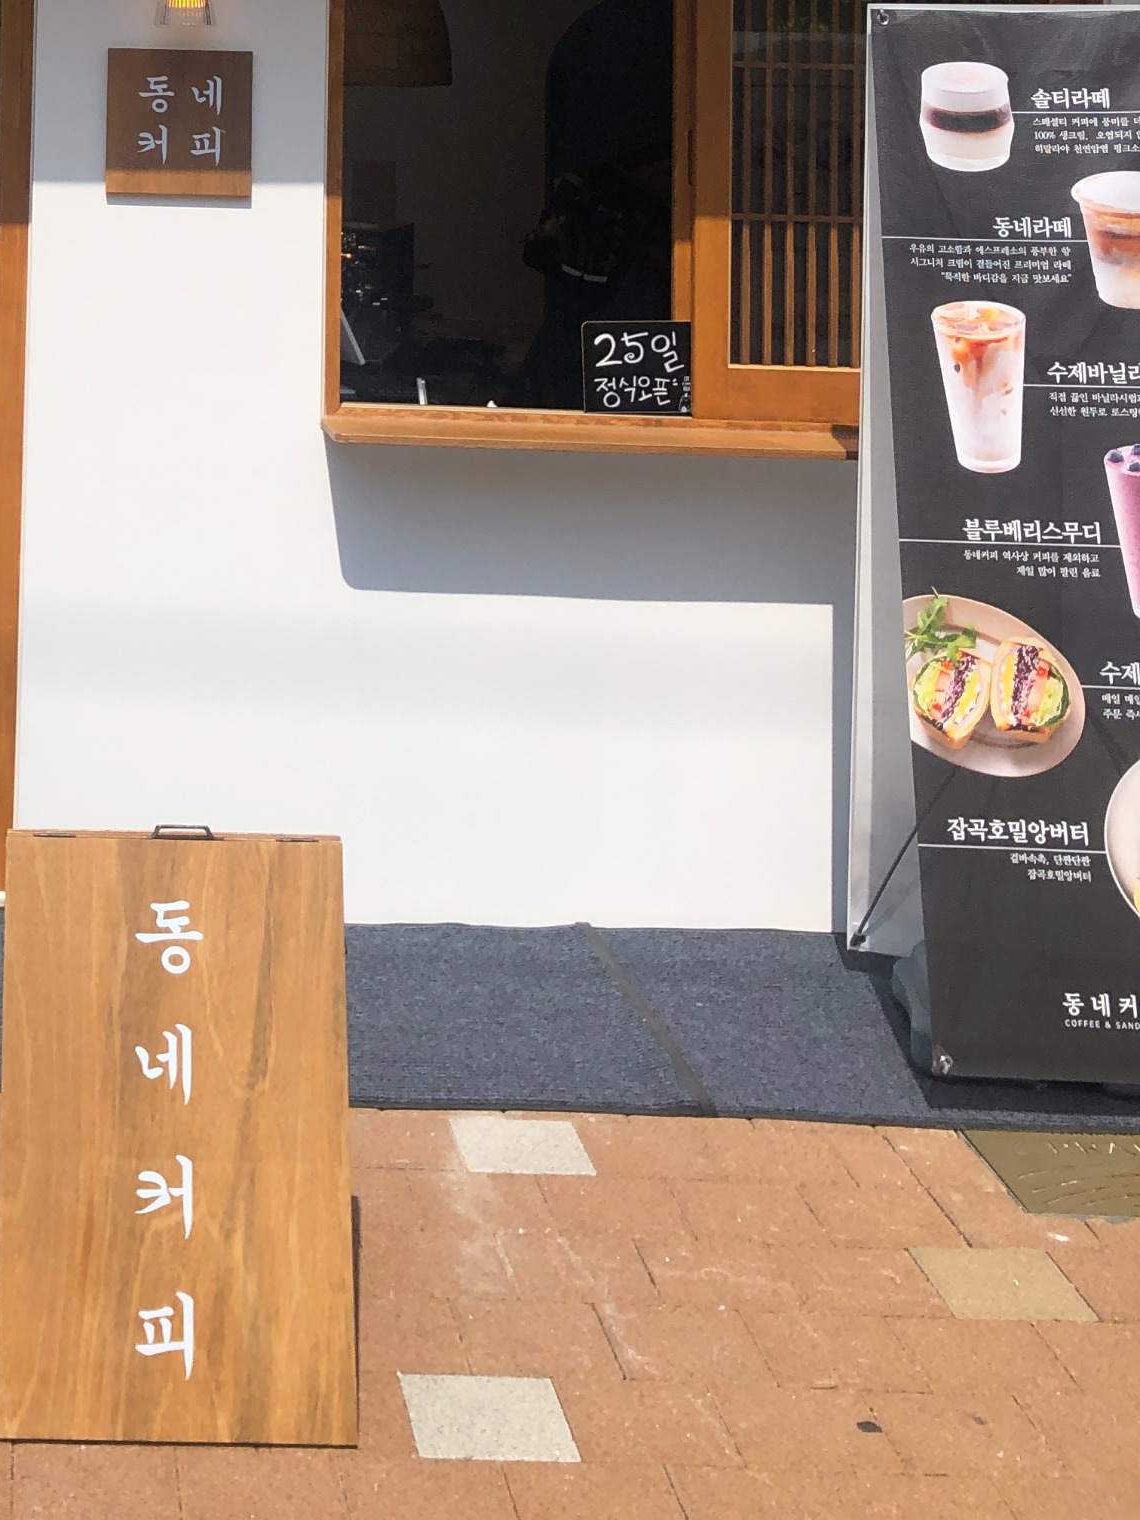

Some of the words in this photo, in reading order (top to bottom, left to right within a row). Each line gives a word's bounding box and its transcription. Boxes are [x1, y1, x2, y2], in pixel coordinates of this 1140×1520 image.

[138, 75, 222, 116] 동네
[1030, 87, 1111, 109] 솔티라떼
[1071, 116, 1099, 128] 커피에
[1101, 116, 1130, 128] 풍미를
[1034, 130, 1057, 140] 100%
[136, 124, 223, 167] 커피
[1034, 143, 1071, 154] 히말라야
[992, 216, 1072, 238] 동네라떼
[909, 243, 935, 254] 우유의
[938, 244, 972, 255] 고소함과
[975, 245, 1027, 256] 에스프레소의
[1030, 246, 1058, 257] 풍부한
[1060, 246, 1072, 257] 향
[910, 256, 944, 268] 시그니처
[947, 258, 973, 269] 크림이
[1014, 260, 1049, 271] 프리미엄
[1052, 260, 1072, 271] 라떼
[973, 272, 1008, 284] 바디감을
[1011, 273, 1030, 284] 지금
[593, 330, 685, 373] 25일
[1048, 392, 1067, 403] 직접
[1070, 392, 1089, 403] 끓인
[1049, 406, 1077, 417] 신선한
[1080, 406, 1108, 417] 원두로
[1111, 407, 1140, 418] 로스팅
[962, 518, 1102, 545] 블루베리스무디
[963, 549, 999, 561] 동네커피
[1002, 550, 1029, 562] 역사상
[1032, 551, 1060, 562] 커피를
[1062, 552, 1100, 564] 제외하고
[1016, 565, 1035, 577] 제일
[1037, 566, 1056, 578] 많이
[1059, 566, 1078, 578] 팔린
[1081, 567, 1101, 579] 음료
[1101, 692, 1121, 705] 매일
[1102, 708, 1123, 720] 주문
[946, 816, 1090, 847] 잡곡호밀앙버터
[1053, 853, 1092, 867] 단짠단짠
[1027, 868, 1092, 883] 잡곡호밀앙버터
[1064, 1018, 1101, 1029] COFFEE
[1104, 1020, 1112, 1029] &
[134, 900, 204, 1381] 동네커피
